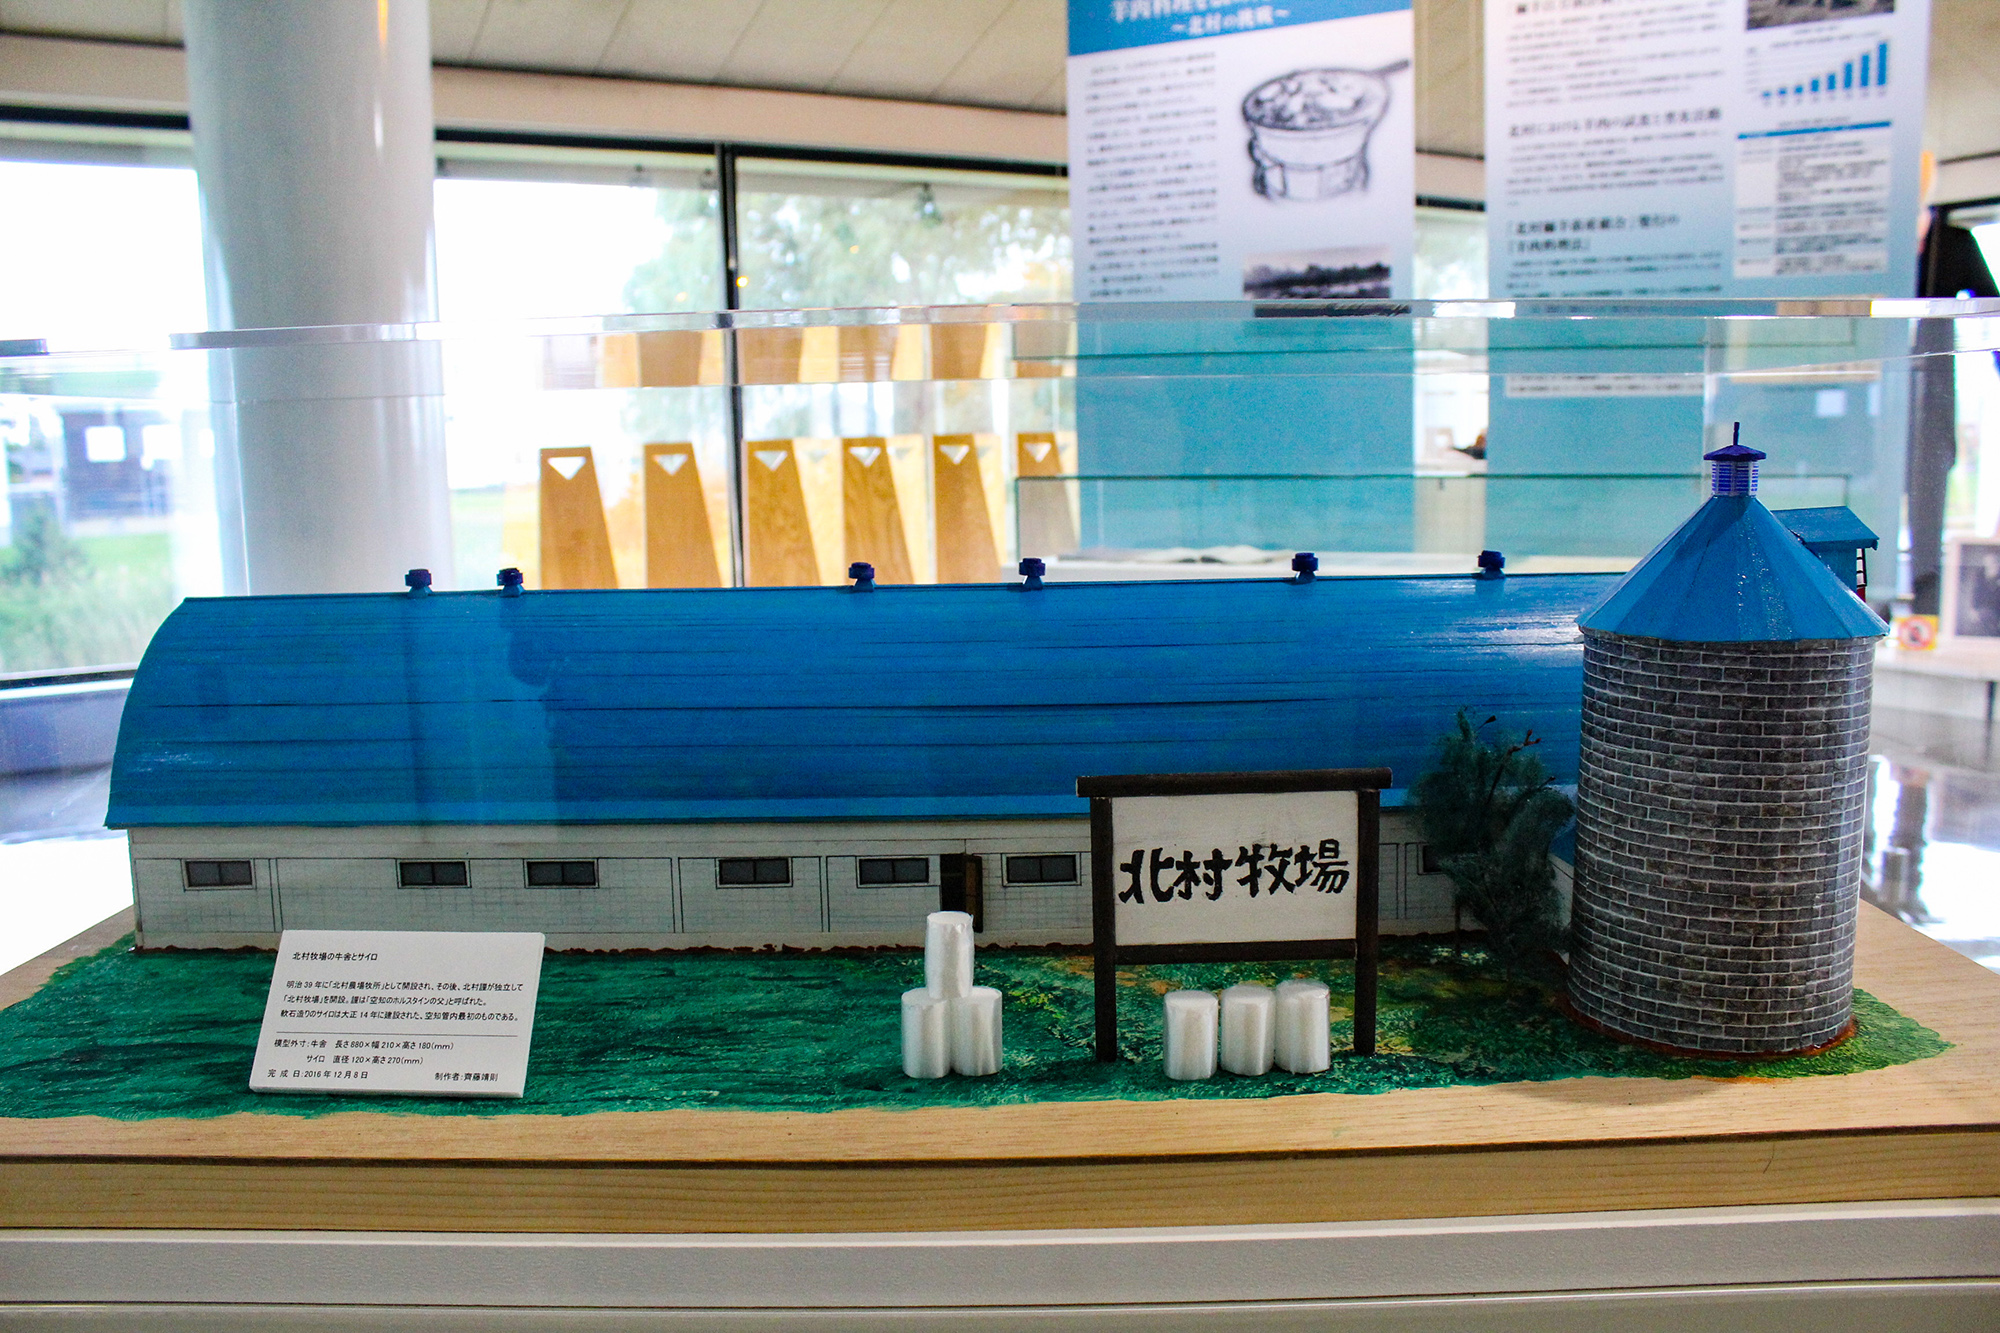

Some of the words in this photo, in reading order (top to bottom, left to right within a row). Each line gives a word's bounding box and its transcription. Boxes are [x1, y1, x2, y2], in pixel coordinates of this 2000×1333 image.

[1118, 838, 1350, 904] 北村牧場
[291, 951, 379, 962] 北村牧場の牛舎とサイロ
[306, 1054, 327, 1064] サイロ
